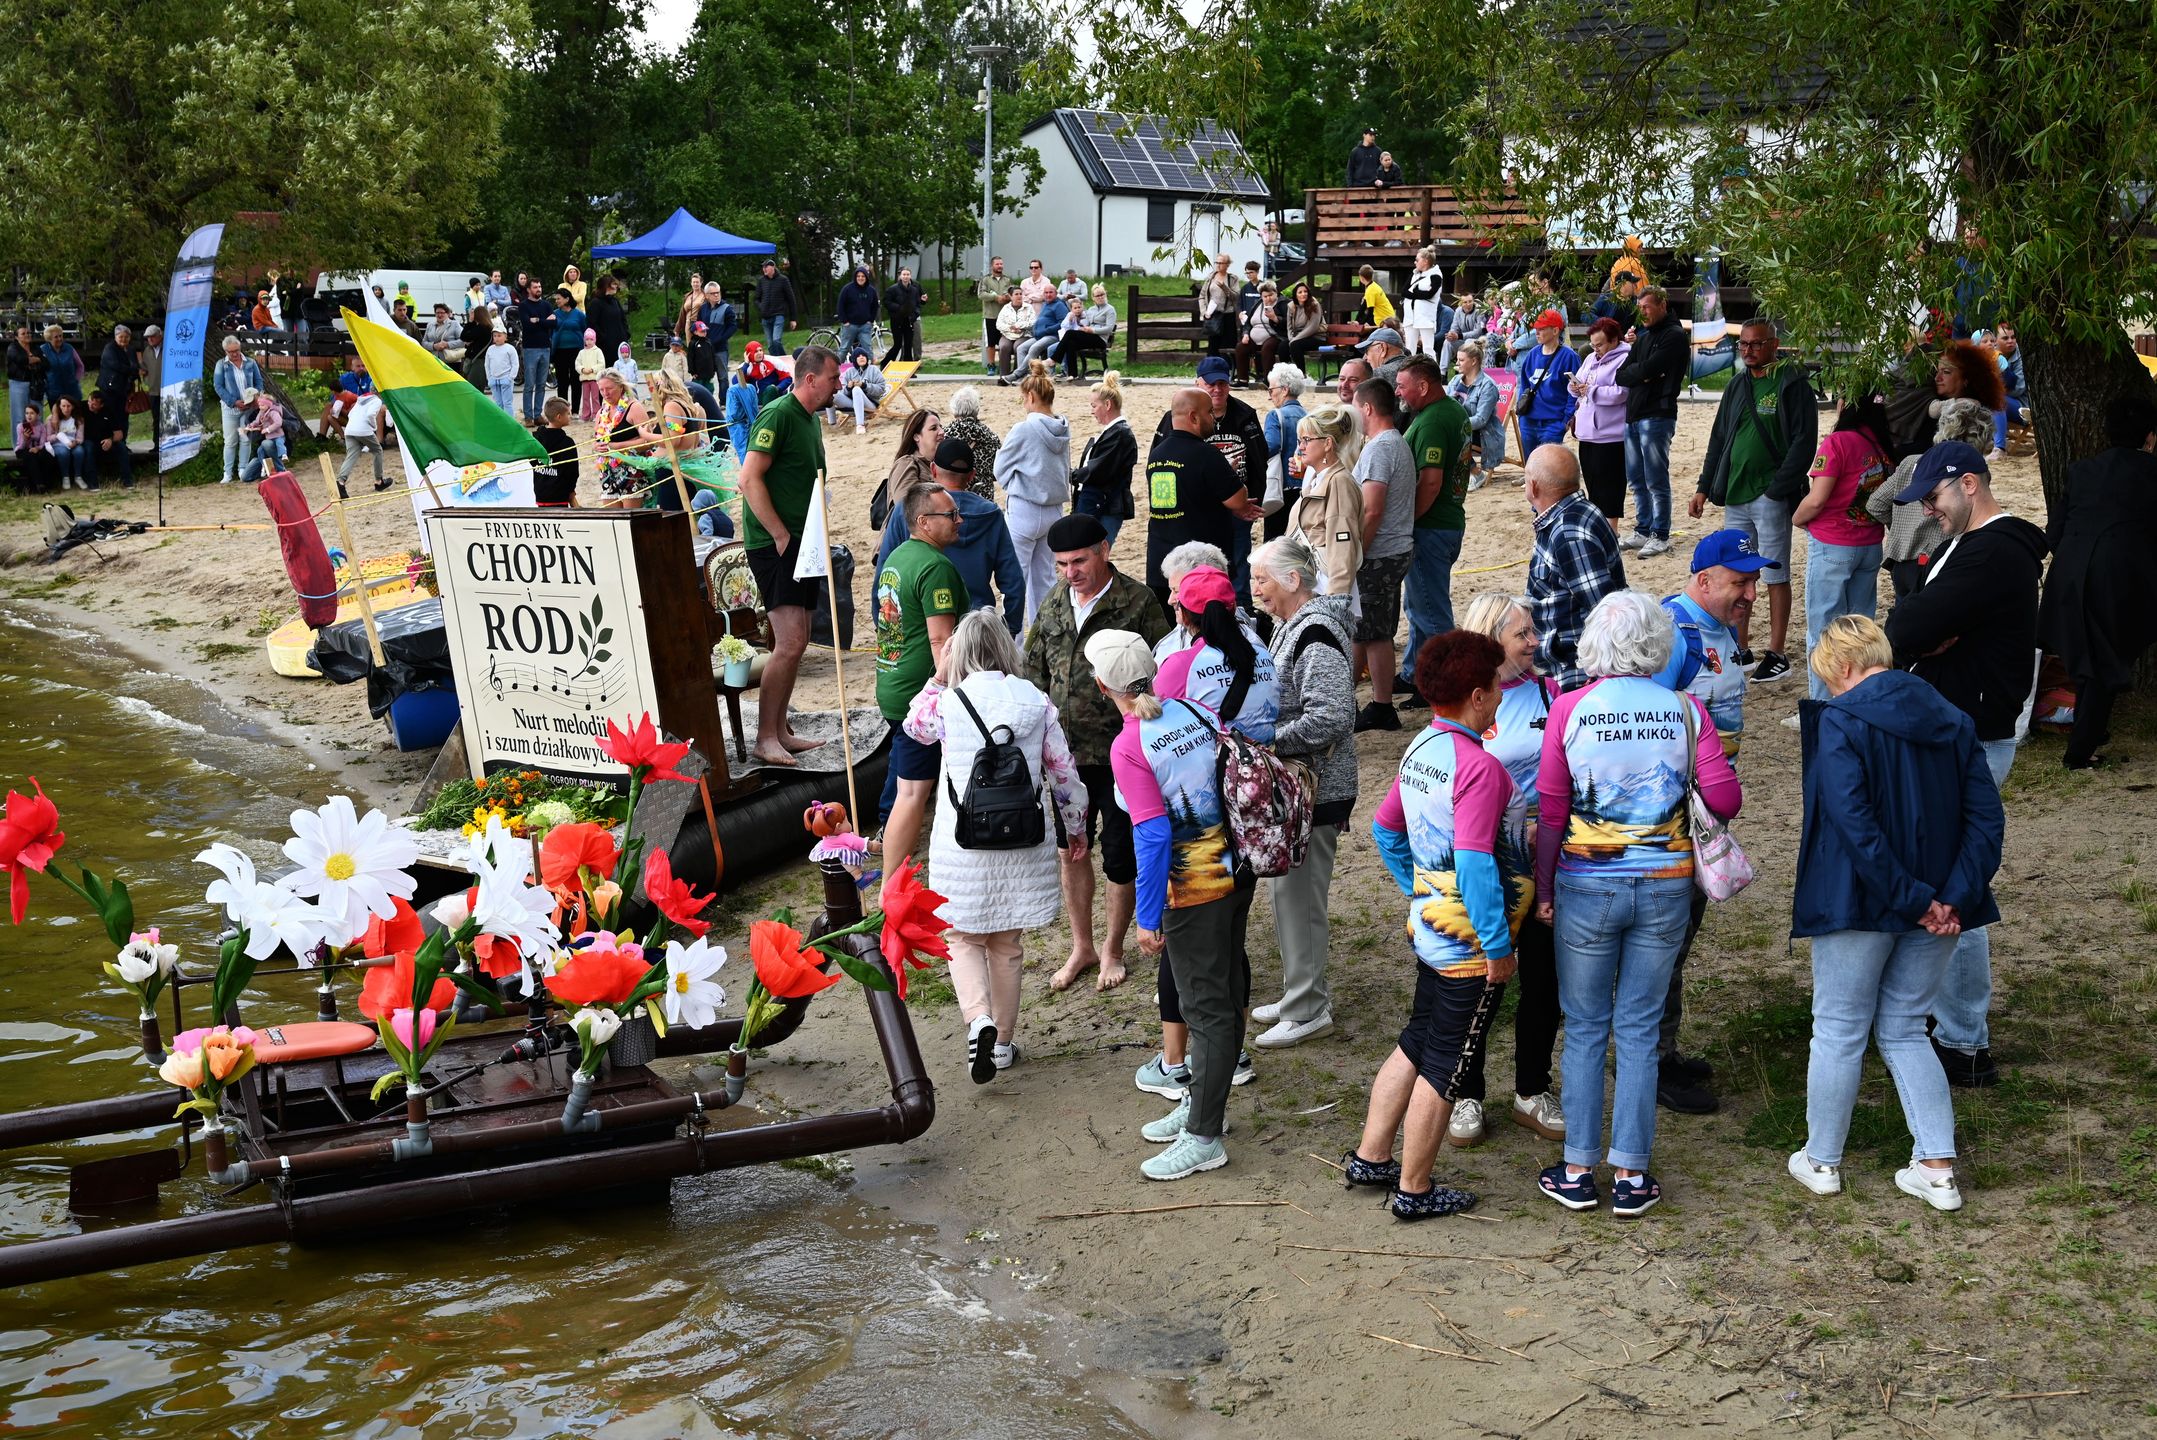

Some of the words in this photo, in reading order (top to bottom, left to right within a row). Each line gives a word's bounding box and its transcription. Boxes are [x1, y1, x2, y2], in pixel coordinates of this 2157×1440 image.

[169, 348, 199, 357] Syrenka
[485, 522, 564, 540] FRYDERYK
[467, 542, 596, 585] CHOPIN
[527, 587, 533, 602] i
[479, 603, 574, 655] ROD
[1197, 662, 1232, 680] NORD
[1217, 677, 1232, 688] TE
[1253, 670, 1273, 683] IKÓŁ
[512, 707, 550, 731] Nurt
[552, 712, 609, 738] melodii
[1579, 712, 1629, 727] NORDIC
[1634, 711, 1685, 724] WALKIN
[485, 730, 493, 751] i
[495, 735, 531, 754] szum
[1150, 728, 1185, 752] NORDIC
[1183, 715, 1214, 735] WALKNG
[1596, 729, 1632, 742] TEAM
[1637, 725, 1677, 741] KIKÓŁ
[1172, 741, 1195, 758] TEAM
[551, 775, 578, 788] OGRODY
[1413, 761, 1449, 784] WALKING
